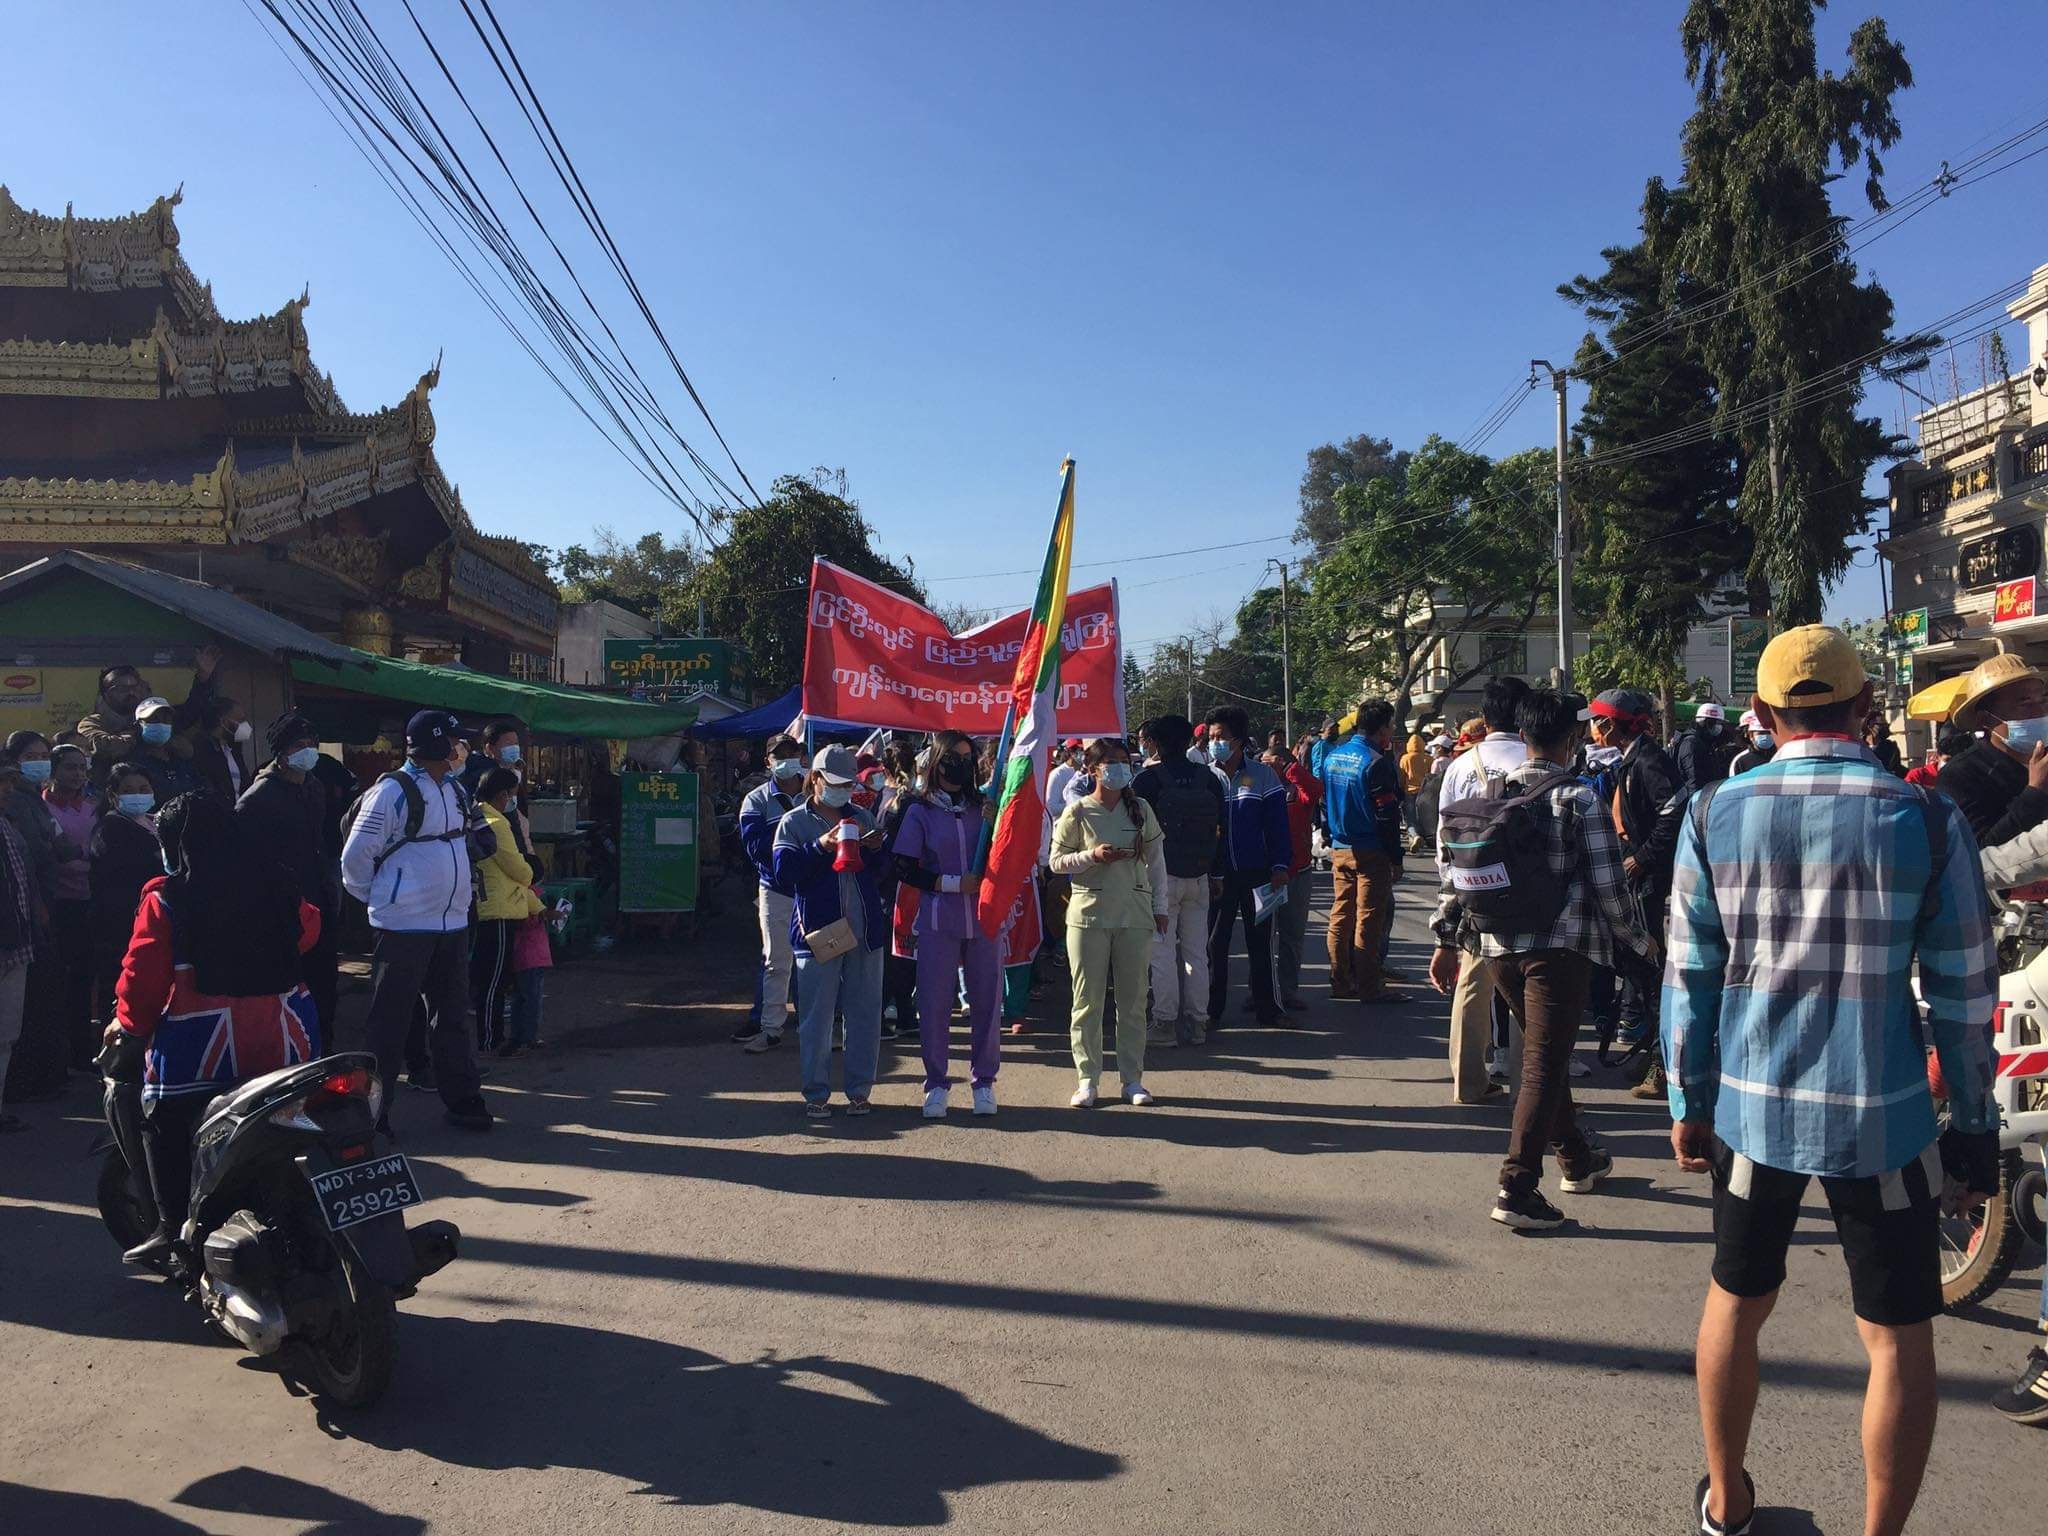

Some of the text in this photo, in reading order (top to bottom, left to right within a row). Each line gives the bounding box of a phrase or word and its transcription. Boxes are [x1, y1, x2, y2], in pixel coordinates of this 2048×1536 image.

[810, 589, 916, 651] ပြင်ဦးလွင်
[1463, 873, 1504, 886] MEDIA
[317, 1159, 402, 1194] MDY-34W
[333, 1182, 411, 1224] 25925
